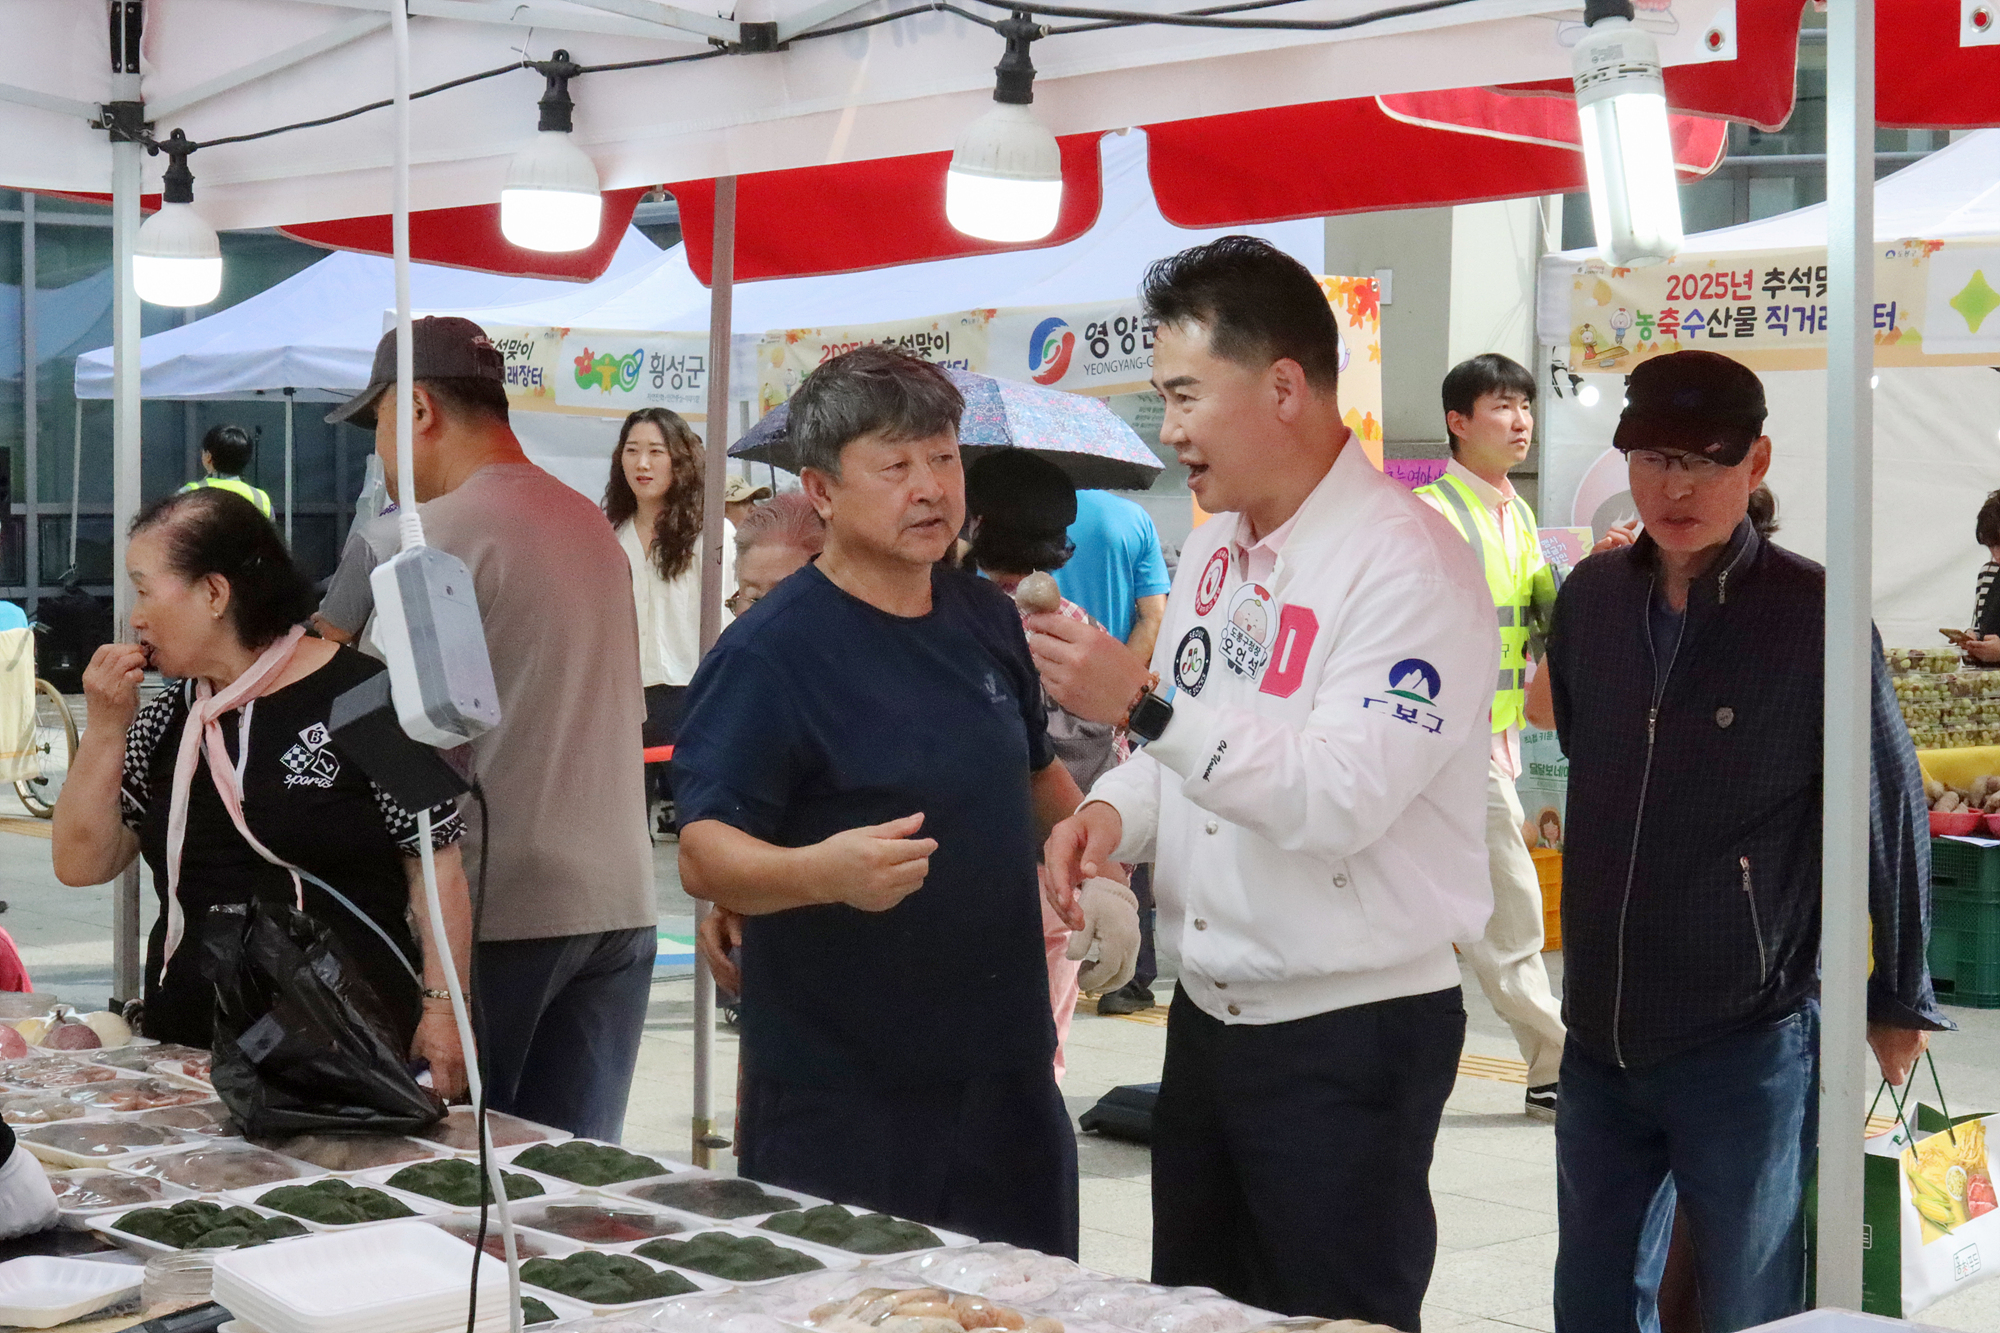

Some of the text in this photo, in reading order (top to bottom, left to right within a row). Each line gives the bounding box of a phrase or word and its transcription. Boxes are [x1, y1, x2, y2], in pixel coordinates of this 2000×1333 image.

[1665, 265, 1828, 301] 2025년 추석맞
[1634, 300, 1897, 341] 농축수산물 직거터
[488, 337, 535, 361] 석맞이
[1083, 354, 1154, 376] YEONGYANG-G
[648, 351, 706, 390] 횡성군
[1221, 638, 1260, 677] 오언석
